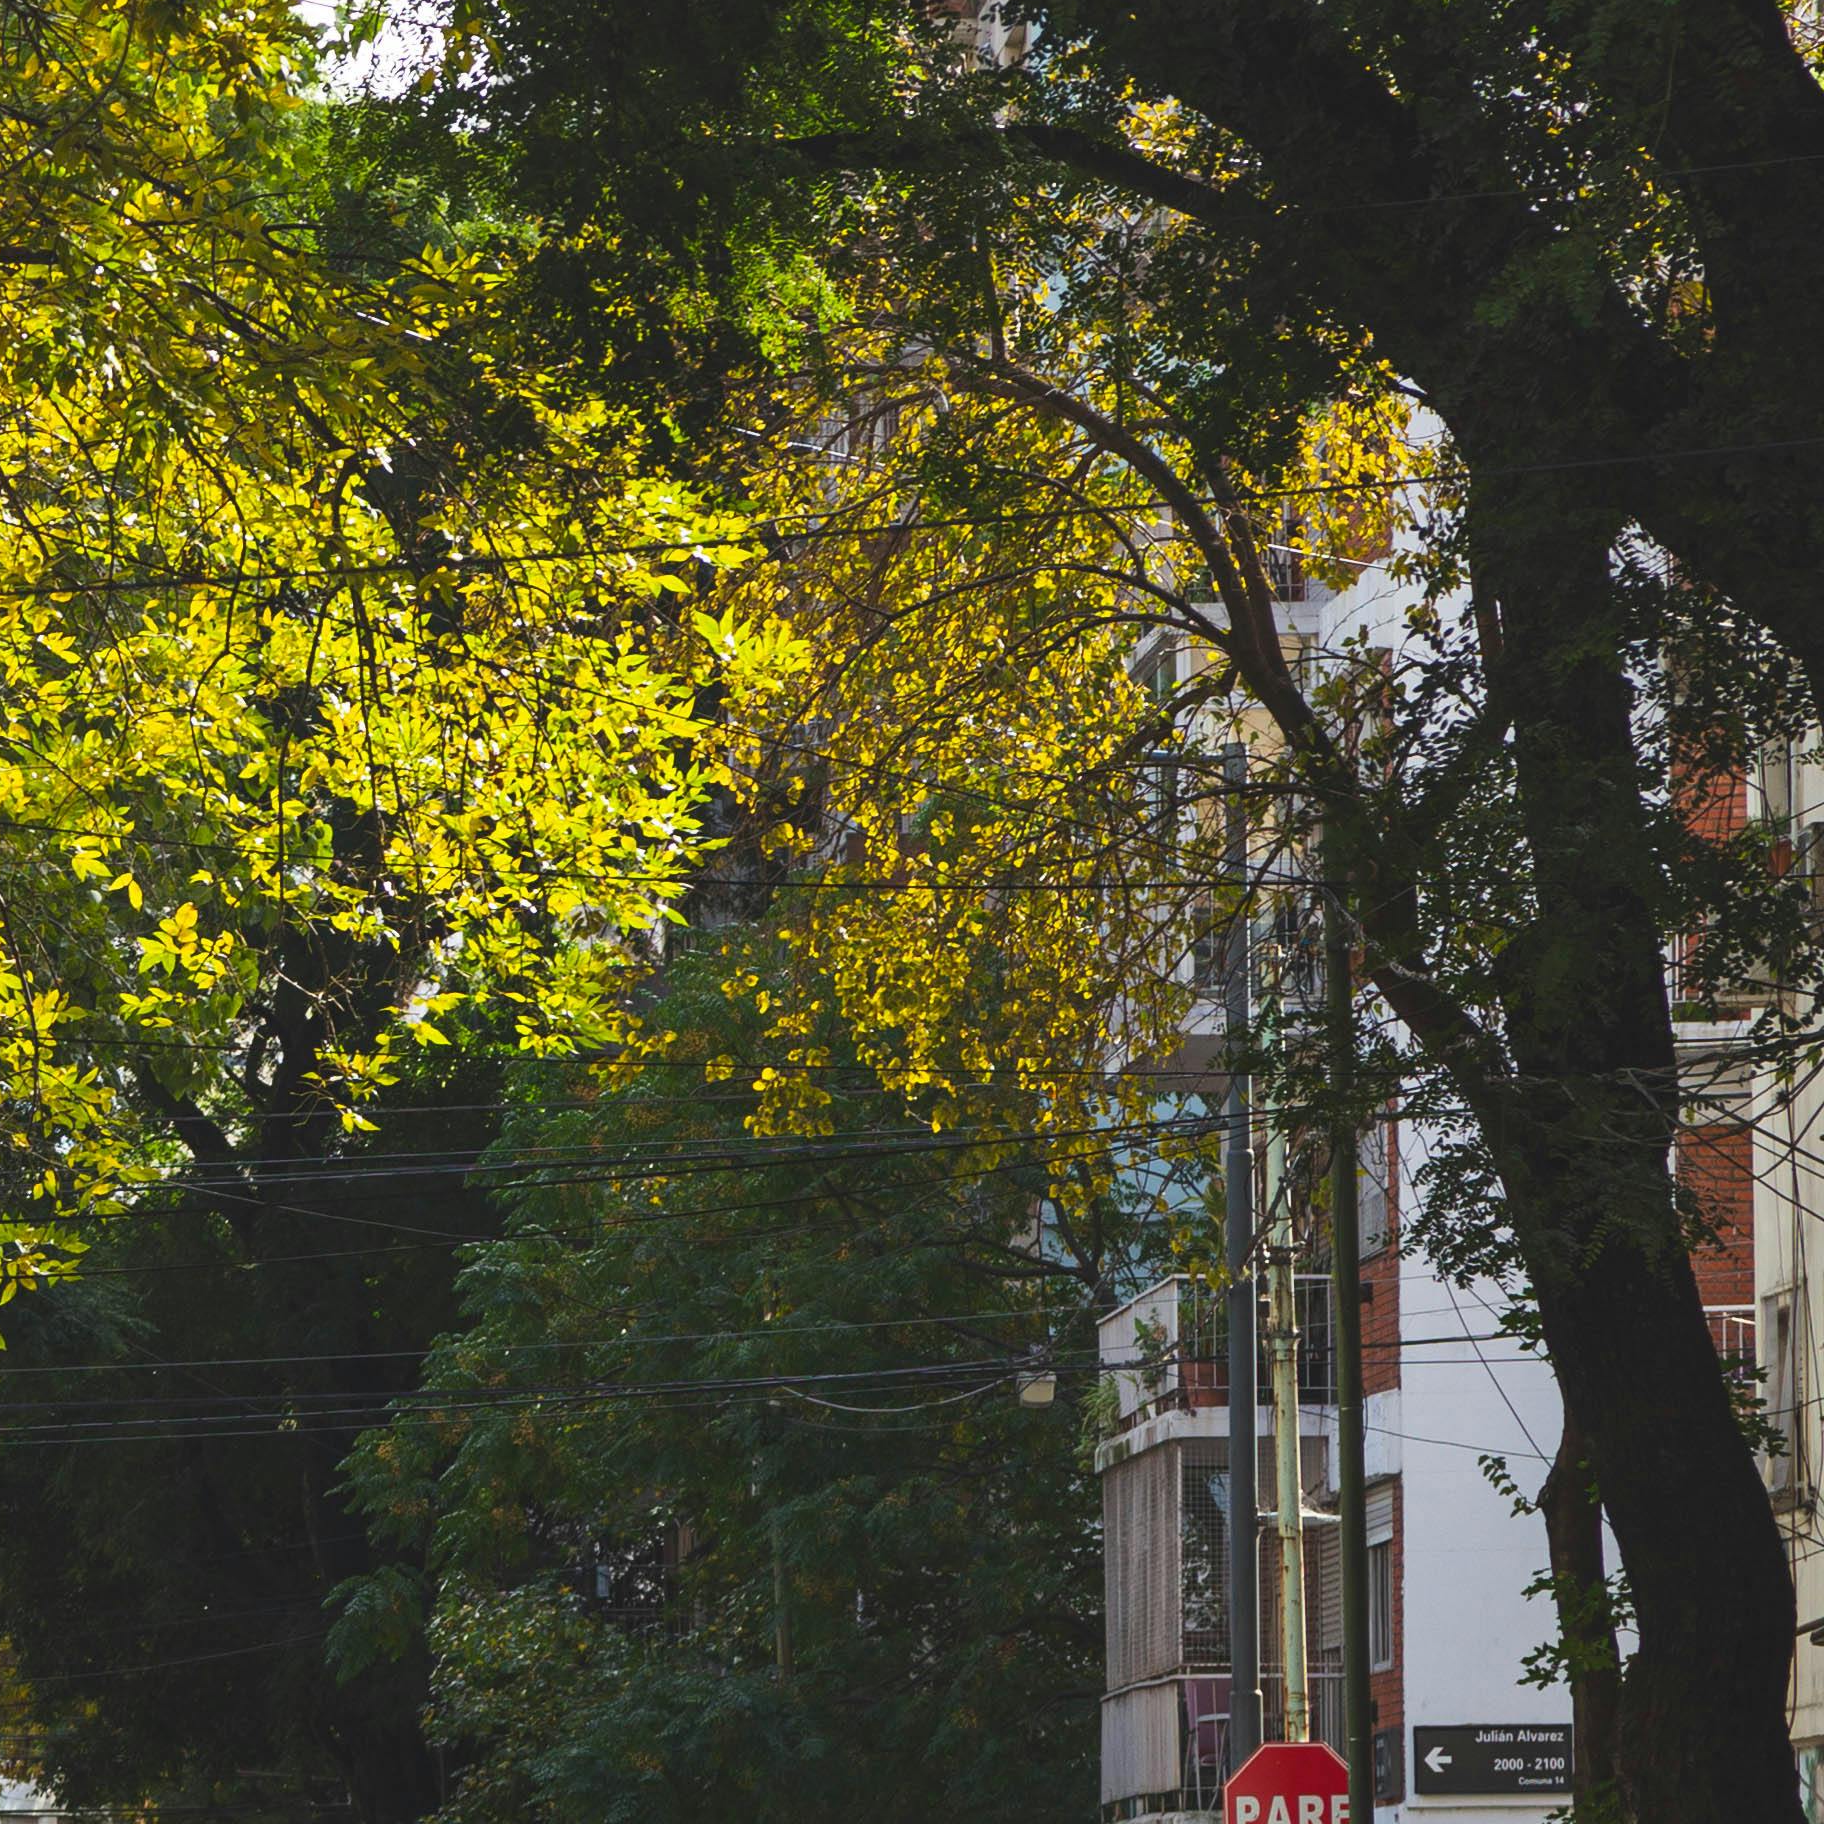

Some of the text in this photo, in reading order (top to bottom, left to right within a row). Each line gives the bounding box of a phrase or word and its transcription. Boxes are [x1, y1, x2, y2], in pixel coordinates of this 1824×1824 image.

[1475, 1730, 1564, 1742] Julián Alvarez
[1493, 1758, 1524, 1771] 2000
[1534, 1757, 1565, 1770] 2100
[1518, 1776, 1565, 1785] Comuna 14
